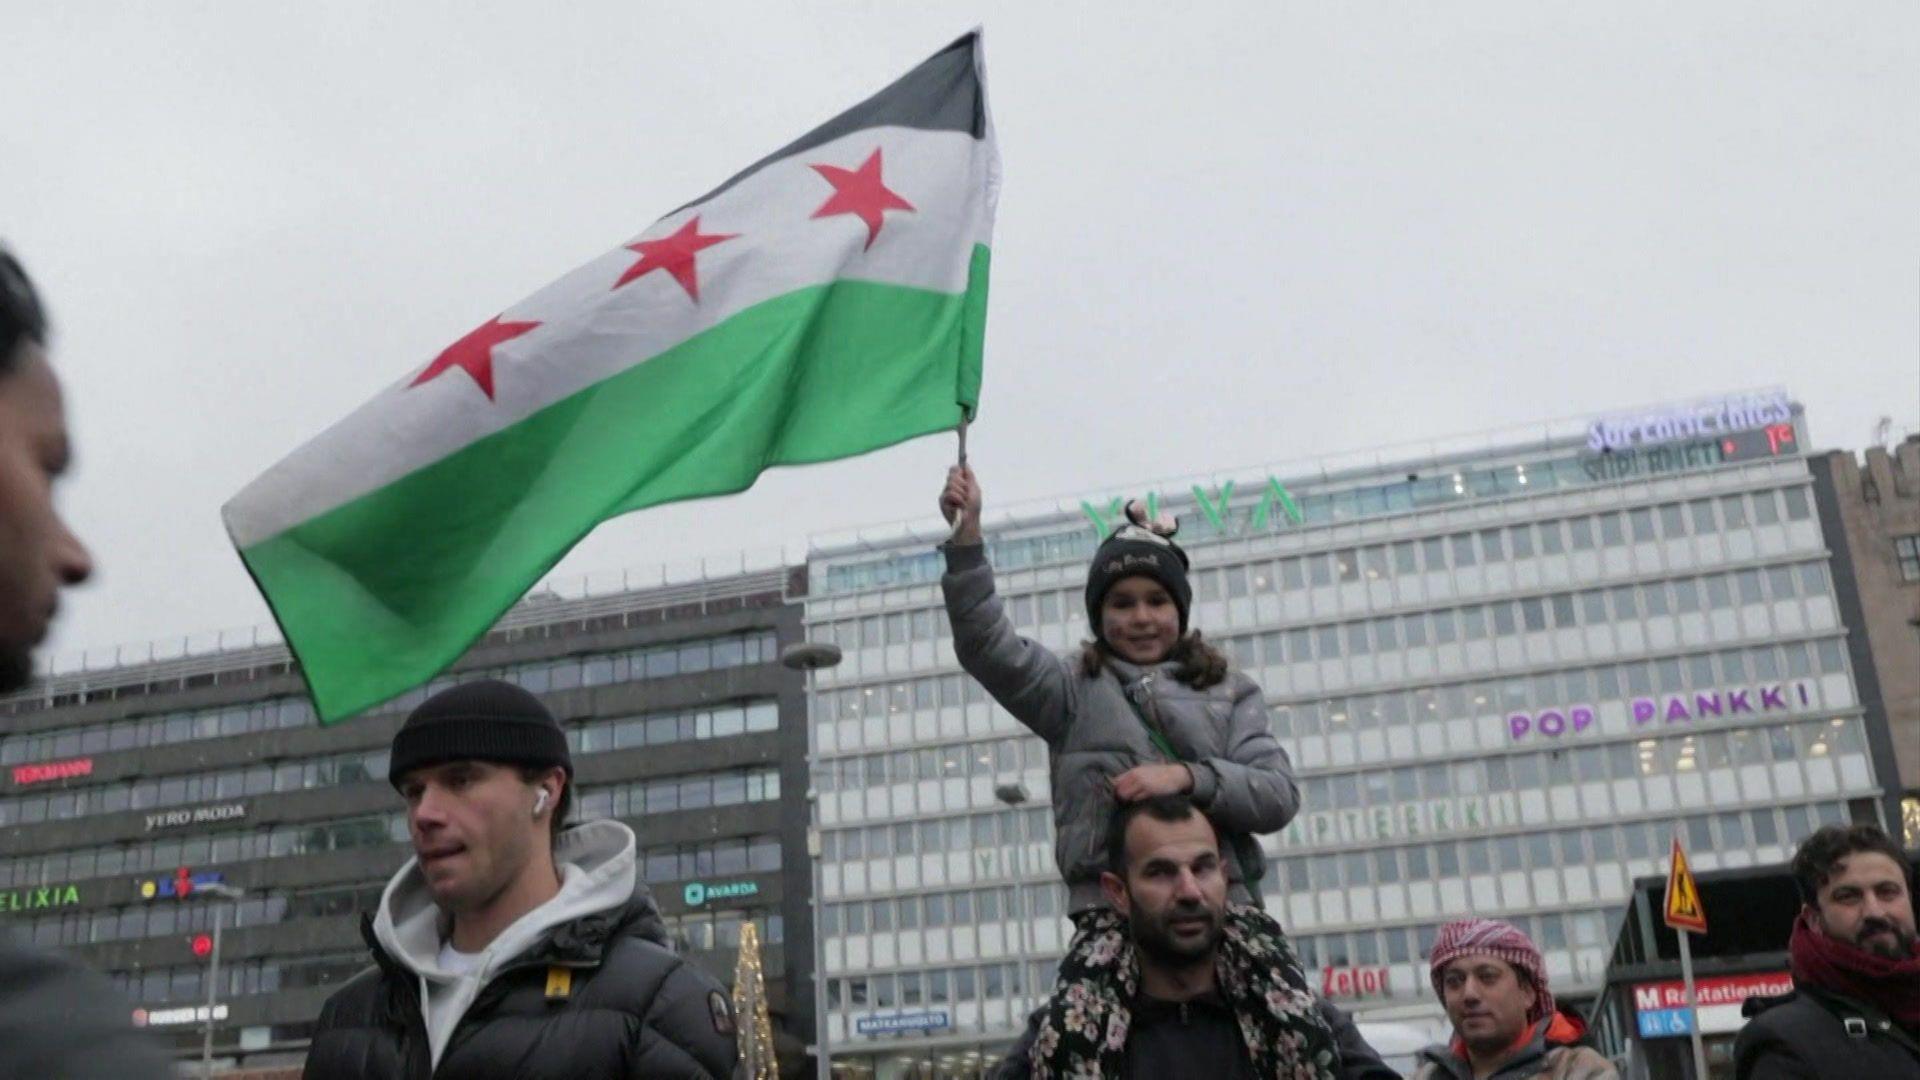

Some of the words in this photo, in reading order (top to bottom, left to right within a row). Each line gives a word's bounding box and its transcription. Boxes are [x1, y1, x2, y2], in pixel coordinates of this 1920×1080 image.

[1509, 706, 1594, 741] POP
[1632, 682, 1809, 725] PANKKI
[193, 804, 244, 822] MODA
[0, 885, 79, 911] ELIXIA
[1322, 965, 1389, 997] Zetor
[1635, 987, 1660, 1010] M
